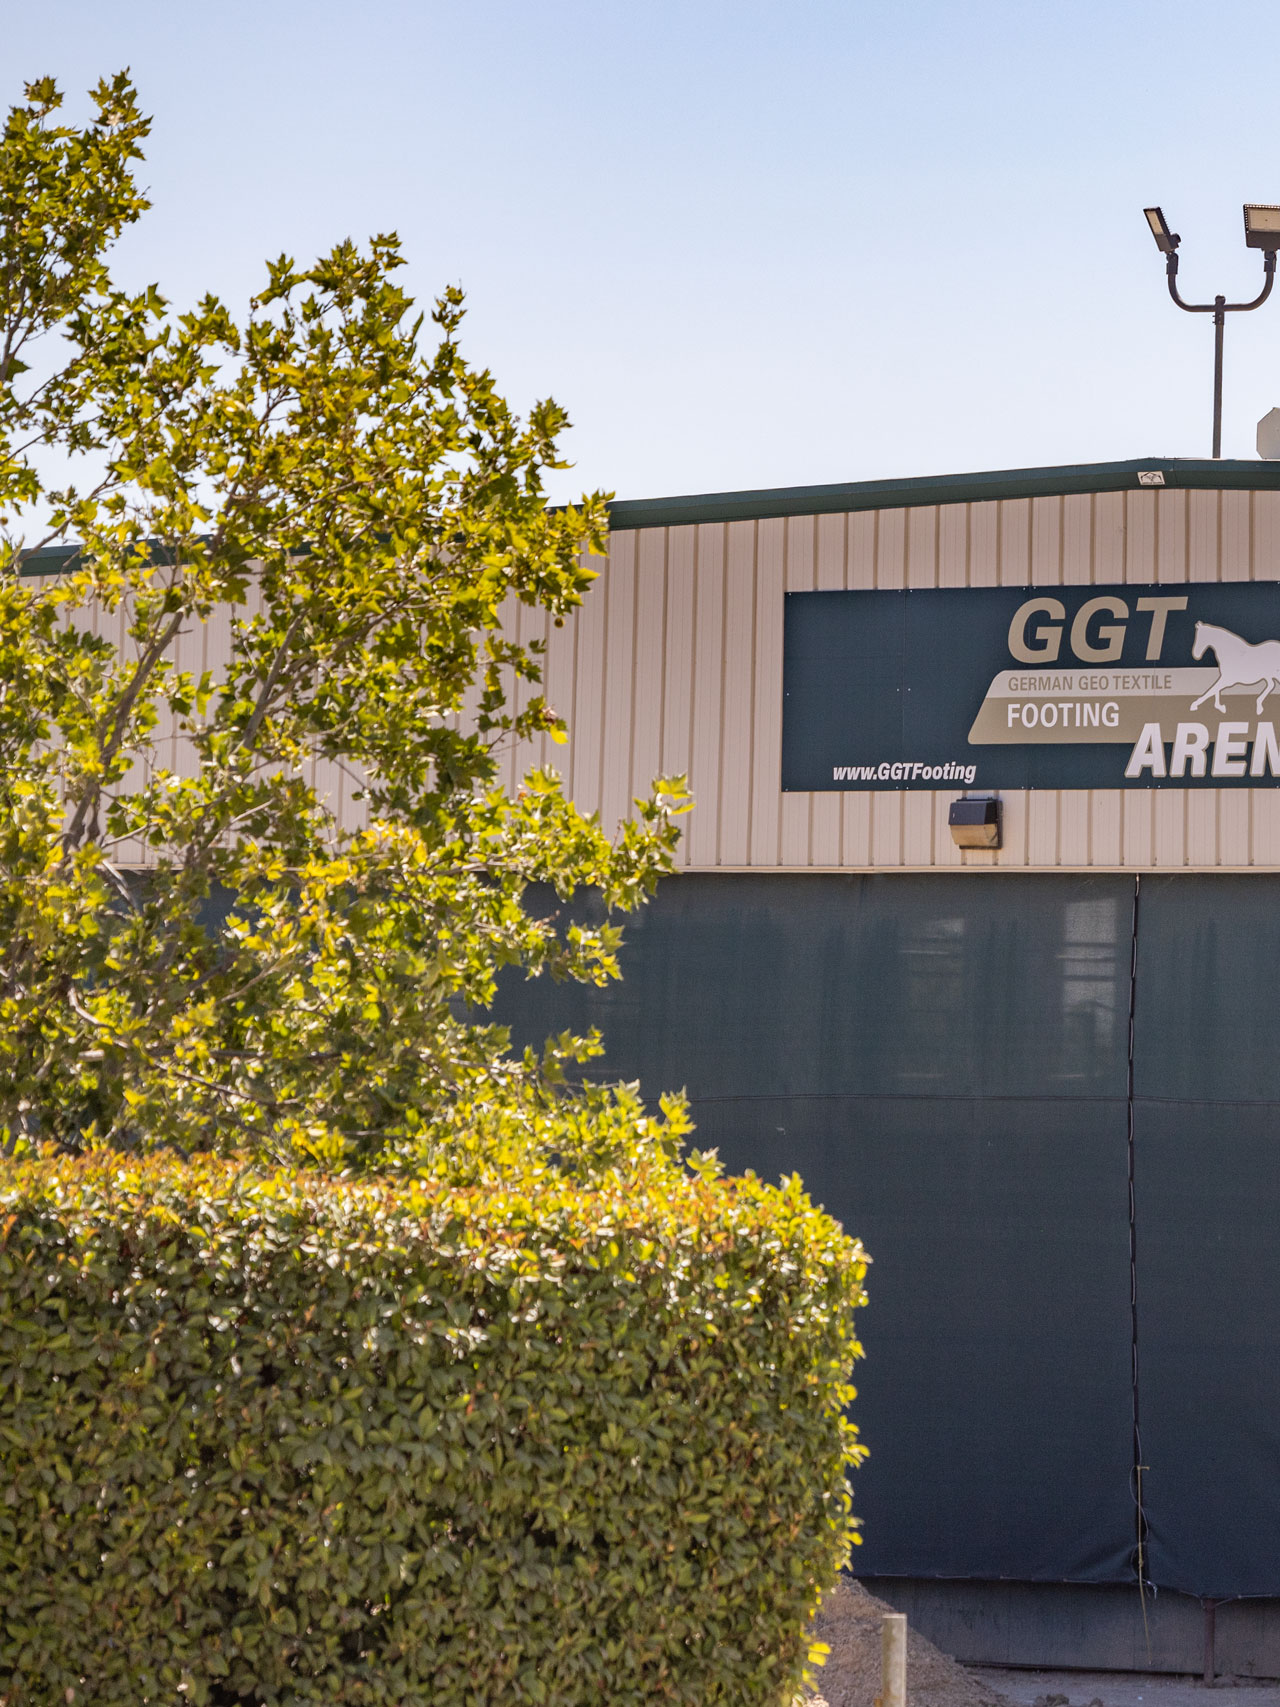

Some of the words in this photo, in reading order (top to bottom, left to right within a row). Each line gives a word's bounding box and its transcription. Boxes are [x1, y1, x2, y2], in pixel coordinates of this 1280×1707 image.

[1007, 596, 1188, 663] GGT
[1008, 676, 1073, 691] GERMAN
[1078, 676, 1109, 691] GEO
[1112, 675, 1172, 690] TEXTILE
[1007, 702, 1120, 728] FOOTING
[833, 762, 976, 784] www.GGTFooting
